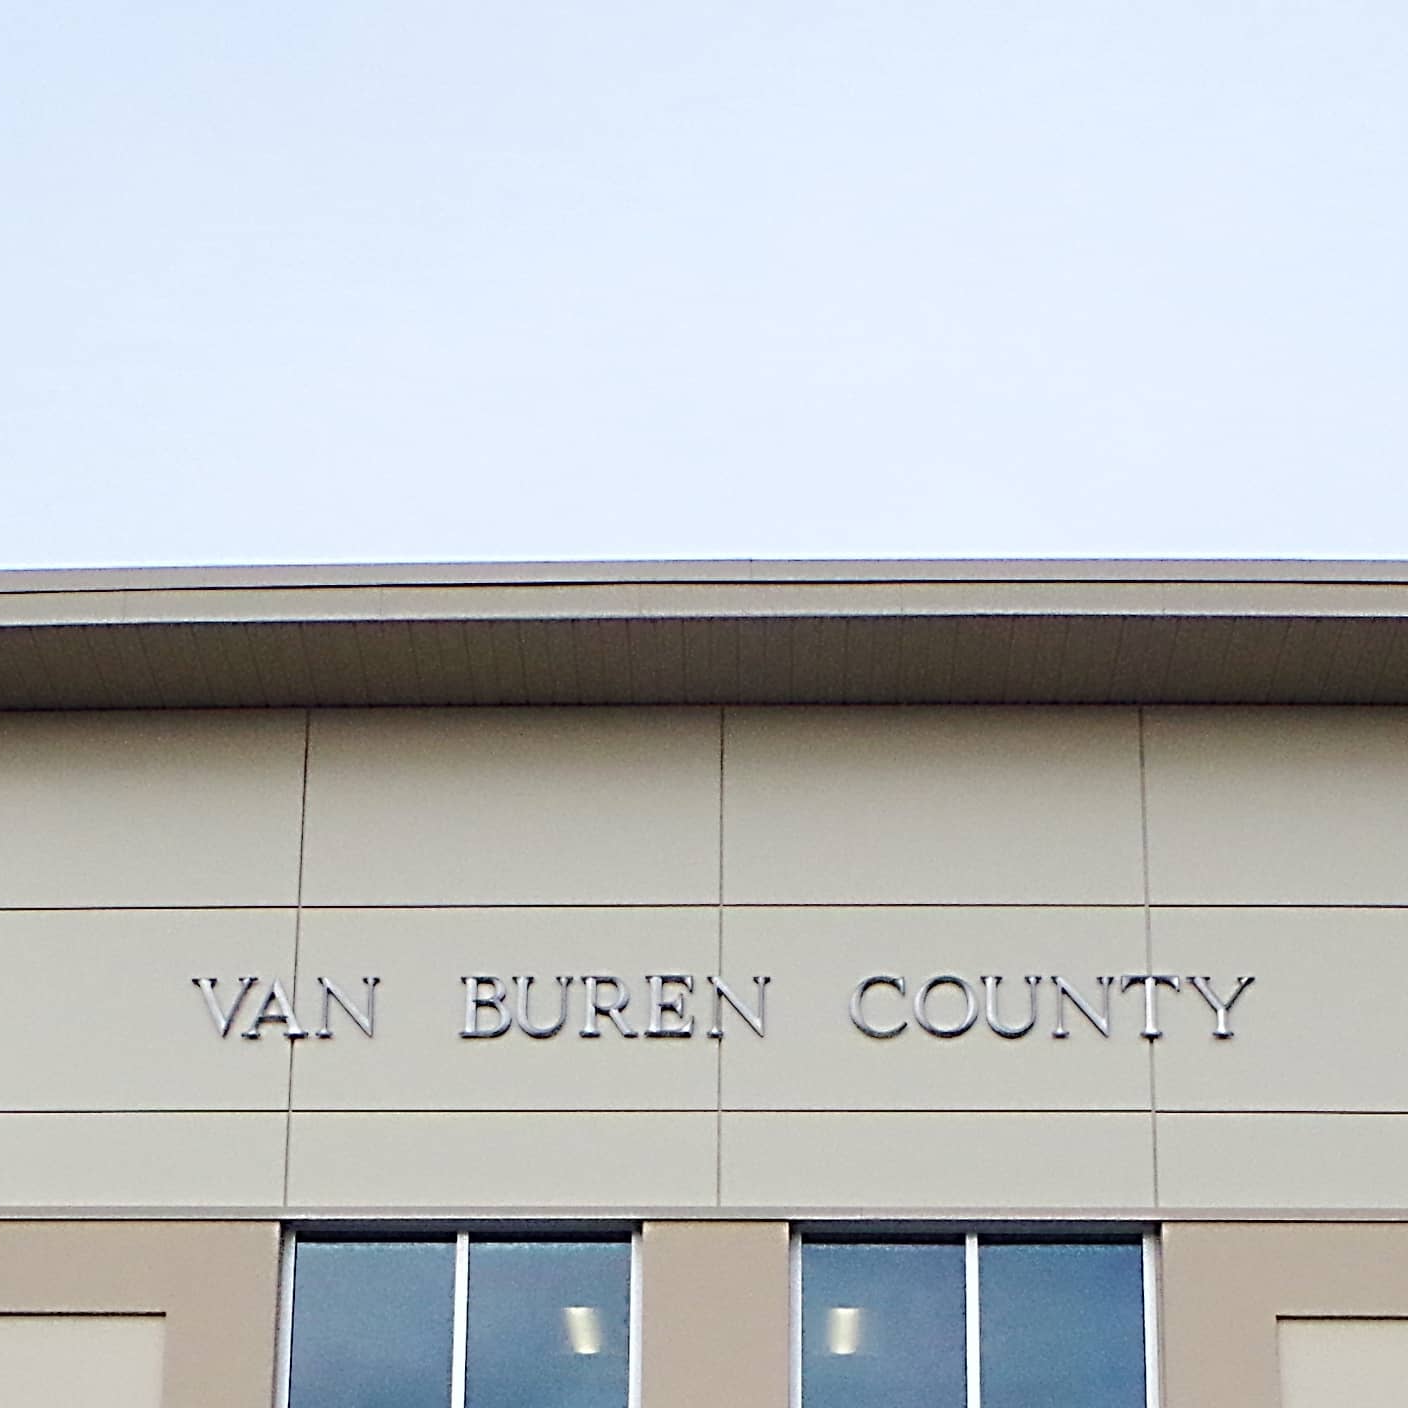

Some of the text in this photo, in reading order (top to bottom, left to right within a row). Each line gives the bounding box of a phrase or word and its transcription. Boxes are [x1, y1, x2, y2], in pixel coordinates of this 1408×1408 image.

[191, 975, 1256, 1040] VAN BUREN COUNTY
